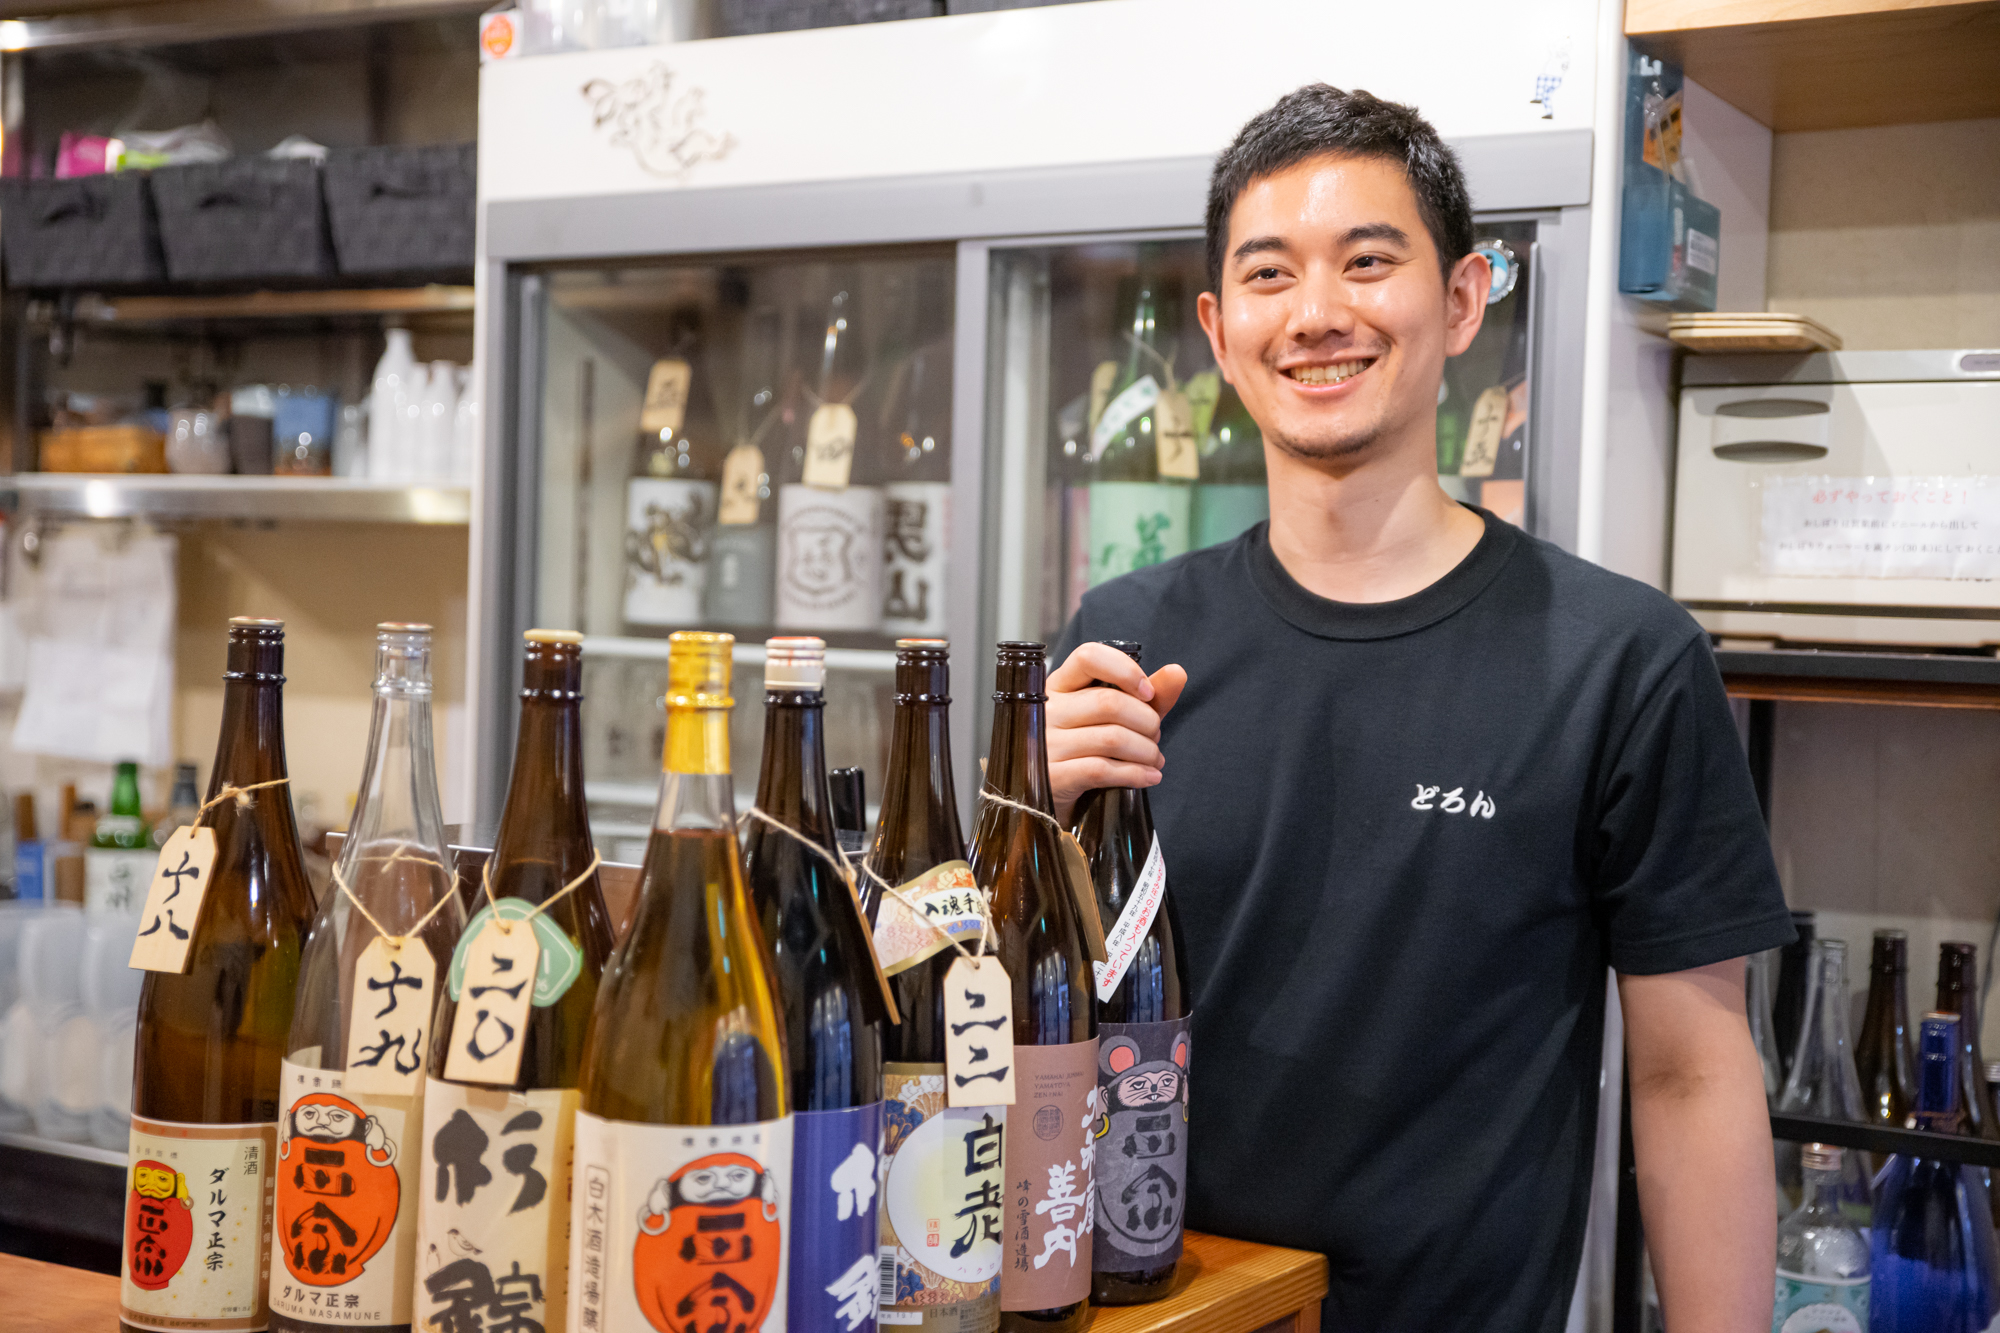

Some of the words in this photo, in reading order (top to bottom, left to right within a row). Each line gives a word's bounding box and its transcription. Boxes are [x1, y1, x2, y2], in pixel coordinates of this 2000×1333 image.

[1411, 783, 1496, 819] どろん
[138, 850, 200, 940] 十八
[350, 961, 423, 1075] 十九
[1034, 1082, 1071, 1090] YAMATOYA
[243, 1146, 259, 1176] 清酒
[206, 1167, 230, 1272] ダルマ正宗
[1014, 1179, 1032, 1273] 峰の雪酒造場
[282, 1285, 360, 1309] ダルマ正宗
[309, 1307, 381, 1321] MASAMUNE
